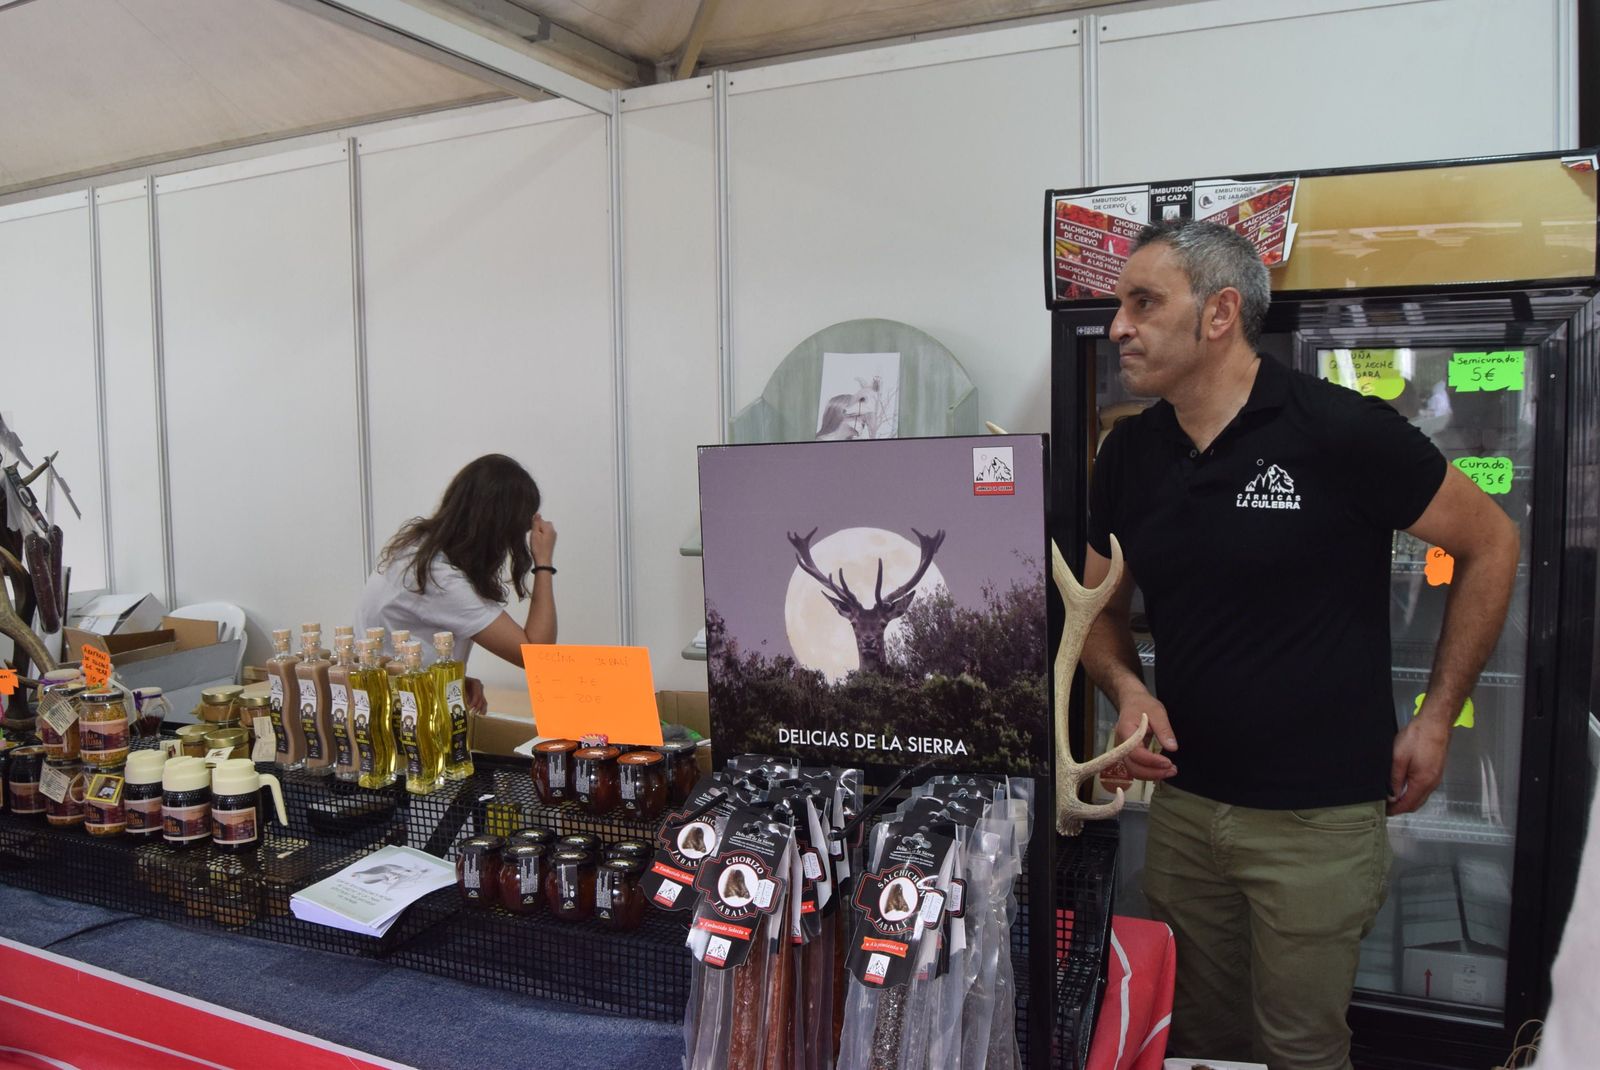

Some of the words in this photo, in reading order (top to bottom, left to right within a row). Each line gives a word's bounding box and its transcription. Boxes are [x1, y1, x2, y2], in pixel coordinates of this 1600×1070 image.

[1150, 185, 1193, 195] EMBUTIDOS
[1060, 222, 1102, 240] SALCHICHÓN
[1112, 226, 1122, 234] DE
[1064, 232, 1073, 240] DE
[1074, 235, 1098, 247] CIERVO
[1082, 250, 1120, 266] SALCHICHÓN
[1059, 262, 1095, 278] SALCHICHÓN
[1085, 277, 1112, 290] PIMIENTA
[1236, 499, 1248, 508] LA
[1251, 500, 1300, 509] CULEBRA
[778, 728, 849, 748] DELICIAS
[855, 733, 876, 749] DE
[881, 734, 902, 751] LA
[908, 736, 968, 756] SIERRA
[671, 849, 698, 867] JABAL
[726, 856, 764, 874] CHORIZO
[714, 900, 749, 917] JABALÍ
